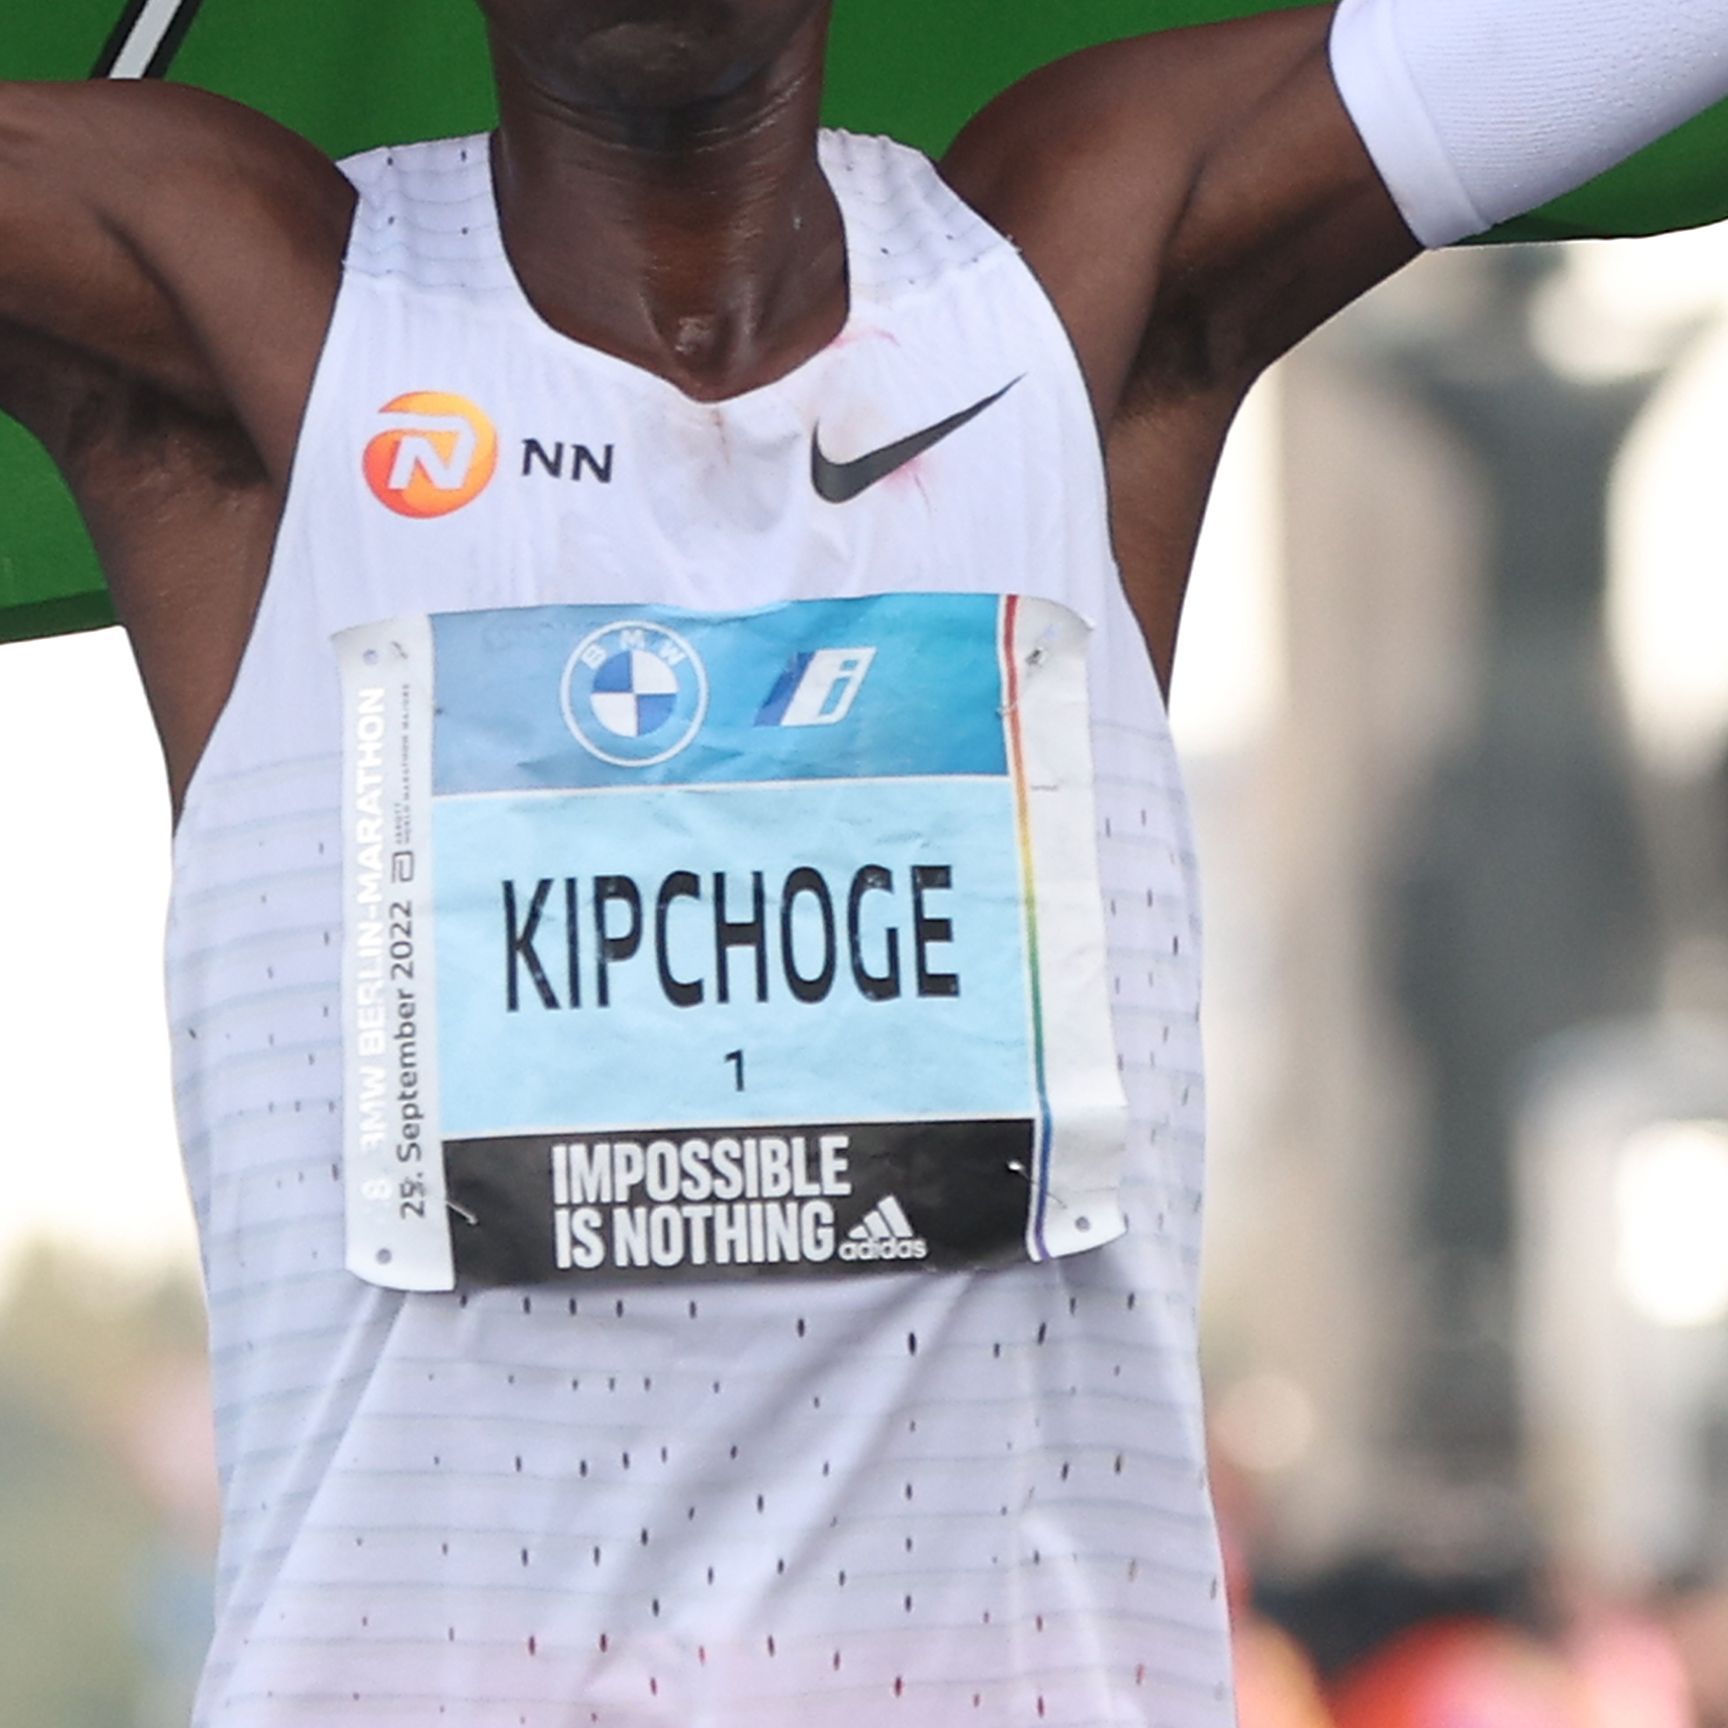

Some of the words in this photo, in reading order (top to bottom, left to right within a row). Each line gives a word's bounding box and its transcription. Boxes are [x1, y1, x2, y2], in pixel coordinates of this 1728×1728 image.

[521, 437, 615, 484] NN
[580, 628, 686, 670] BMW
[354, 686, 387, 1056] BERLIN-MARATHON
[389, 900, 415, 981] 2022
[502, 863, 961, 1013] KIPCHOGE
[393, 988, 424, 1164] September
[724, 1049, 745, 1092] 1
[550, 1134, 852, 1205] IMPOSSIBLE
[554, 1206, 604, 1270] IS
[611, 1199, 835, 1268] NOTHING
[837, 1235, 928, 1262] adidas
